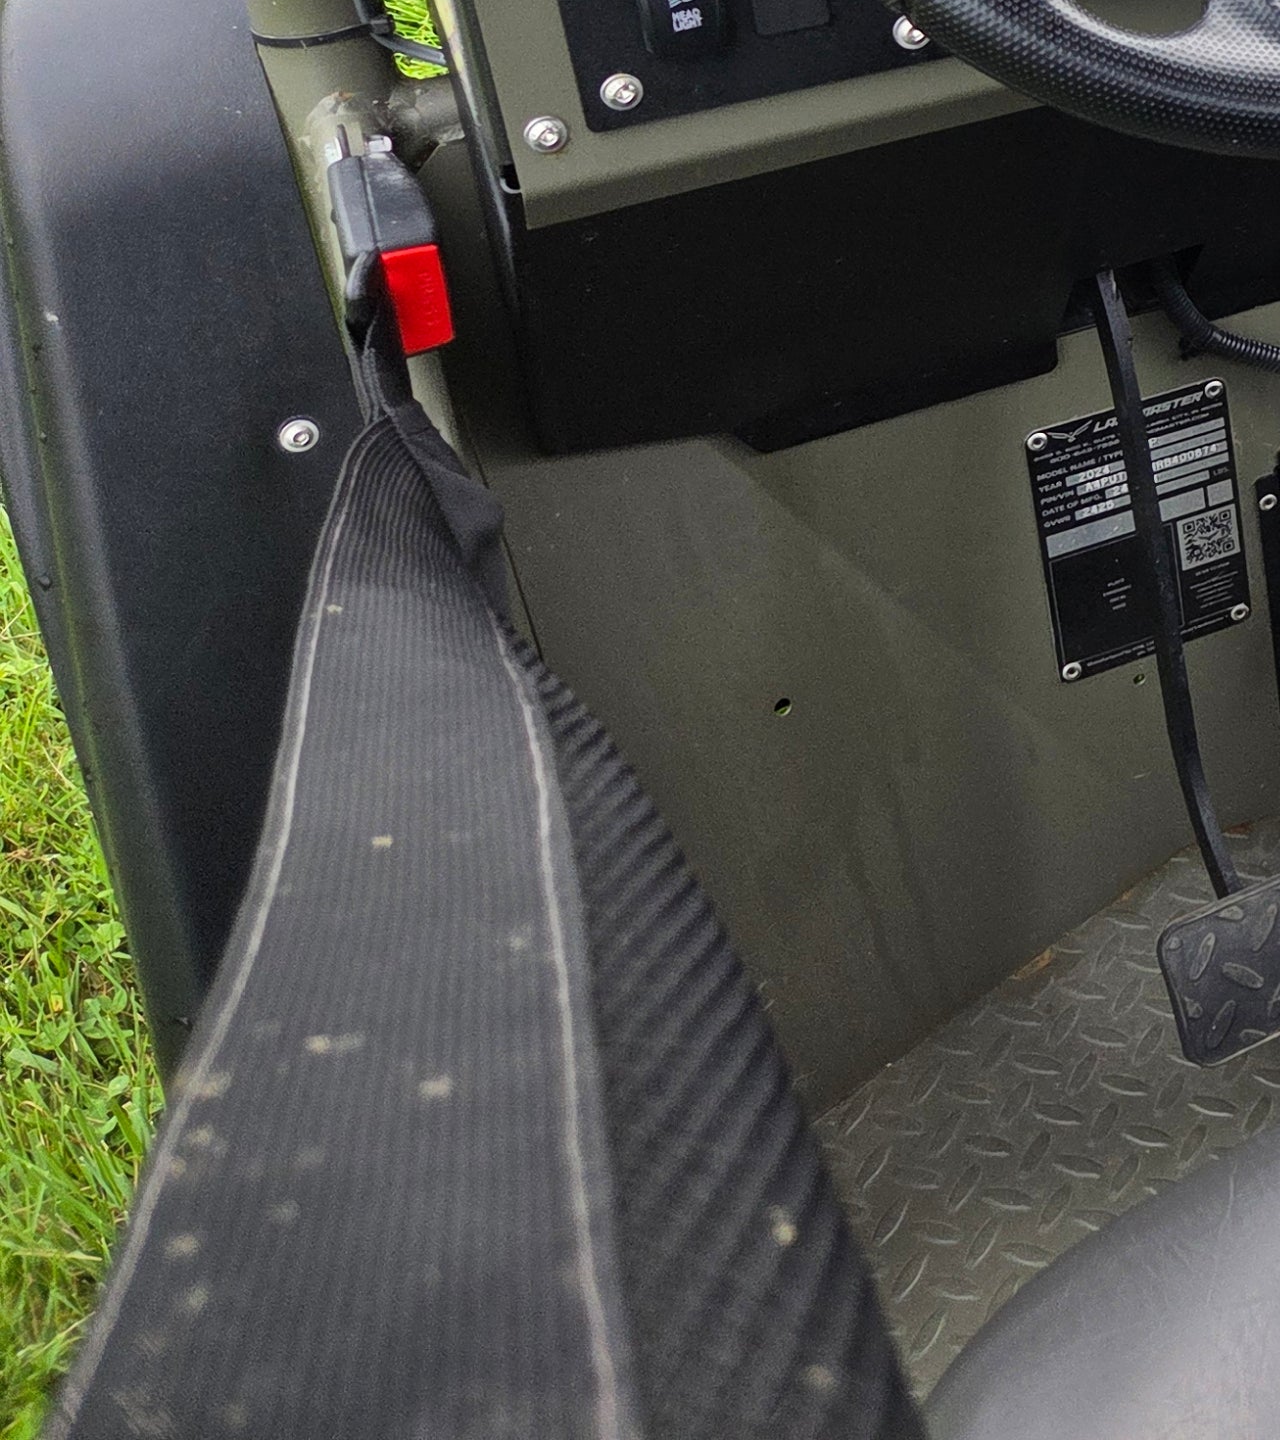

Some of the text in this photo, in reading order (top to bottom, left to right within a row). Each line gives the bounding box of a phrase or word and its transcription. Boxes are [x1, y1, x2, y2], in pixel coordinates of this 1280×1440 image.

[671, 8, 701, 21] HEAD
[673, 17, 703, 32] LIGHT
[1037, 468, 1069, 481] MODEL
[1070, 459, 1096, 472] NAME
[1039, 481, 1062, 493] YEAR
[1040, 490, 1074, 505] PIN/VIN
[1042, 505, 1065, 517] DATE
[1067, 500, 1079, 509] OF
[1044, 515, 1071, 527] GVWR
